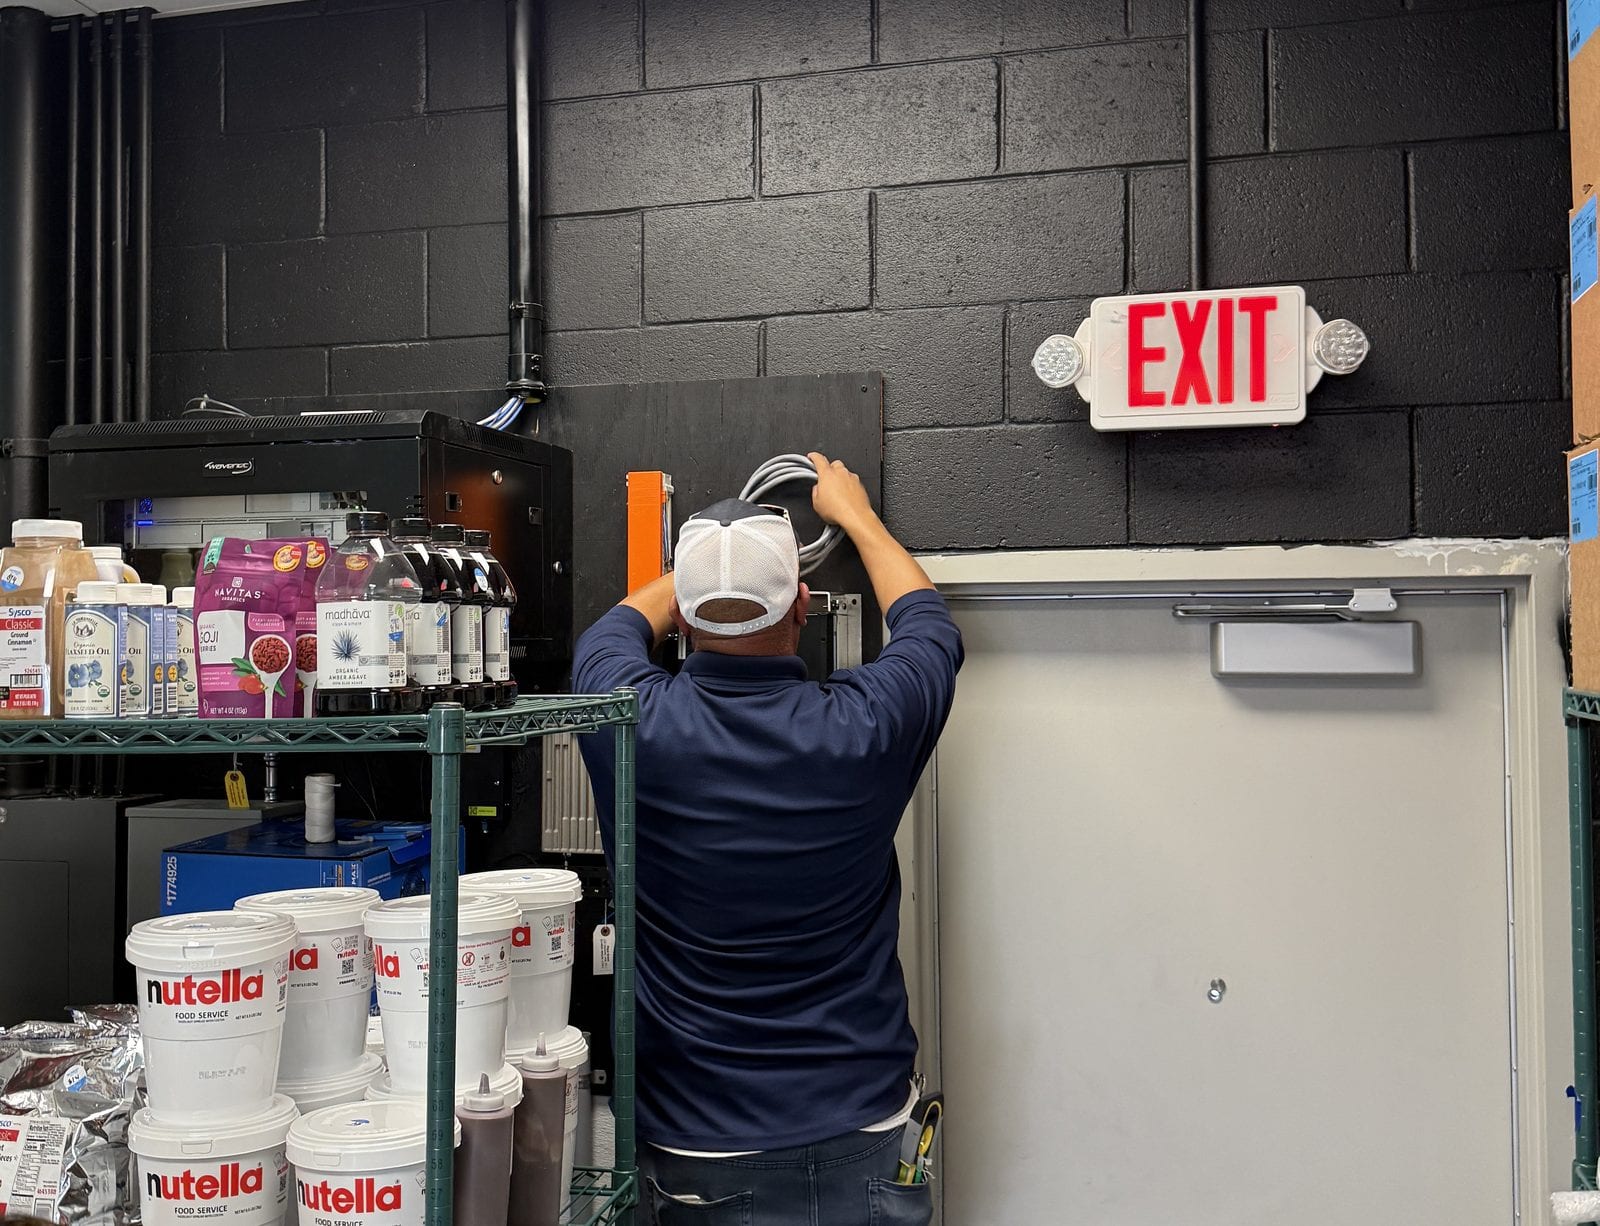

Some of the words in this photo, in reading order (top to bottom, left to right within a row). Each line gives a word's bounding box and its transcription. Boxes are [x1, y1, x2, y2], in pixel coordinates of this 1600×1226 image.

[1128, 296, 1278, 407] EXIT
[215, 588, 261, 599] NAVITAS
[8, 607, 32, 618] Sysco
[5, 619, 35, 630] Classic
[434, 928, 448, 940] 66
[147, 968, 264, 1006] nutella
[175, 1012, 196, 1020] FOOD
[198, 1009, 229, 1019] SERVICE
[147, 1162, 263, 1200] nutella
[297, 1177, 402, 1214] nutella
[174, 1206, 195, 1215] FOOD
[197, 1205, 228, 1214] SERVICE
[315, 1217, 332, 1226] FOOD
